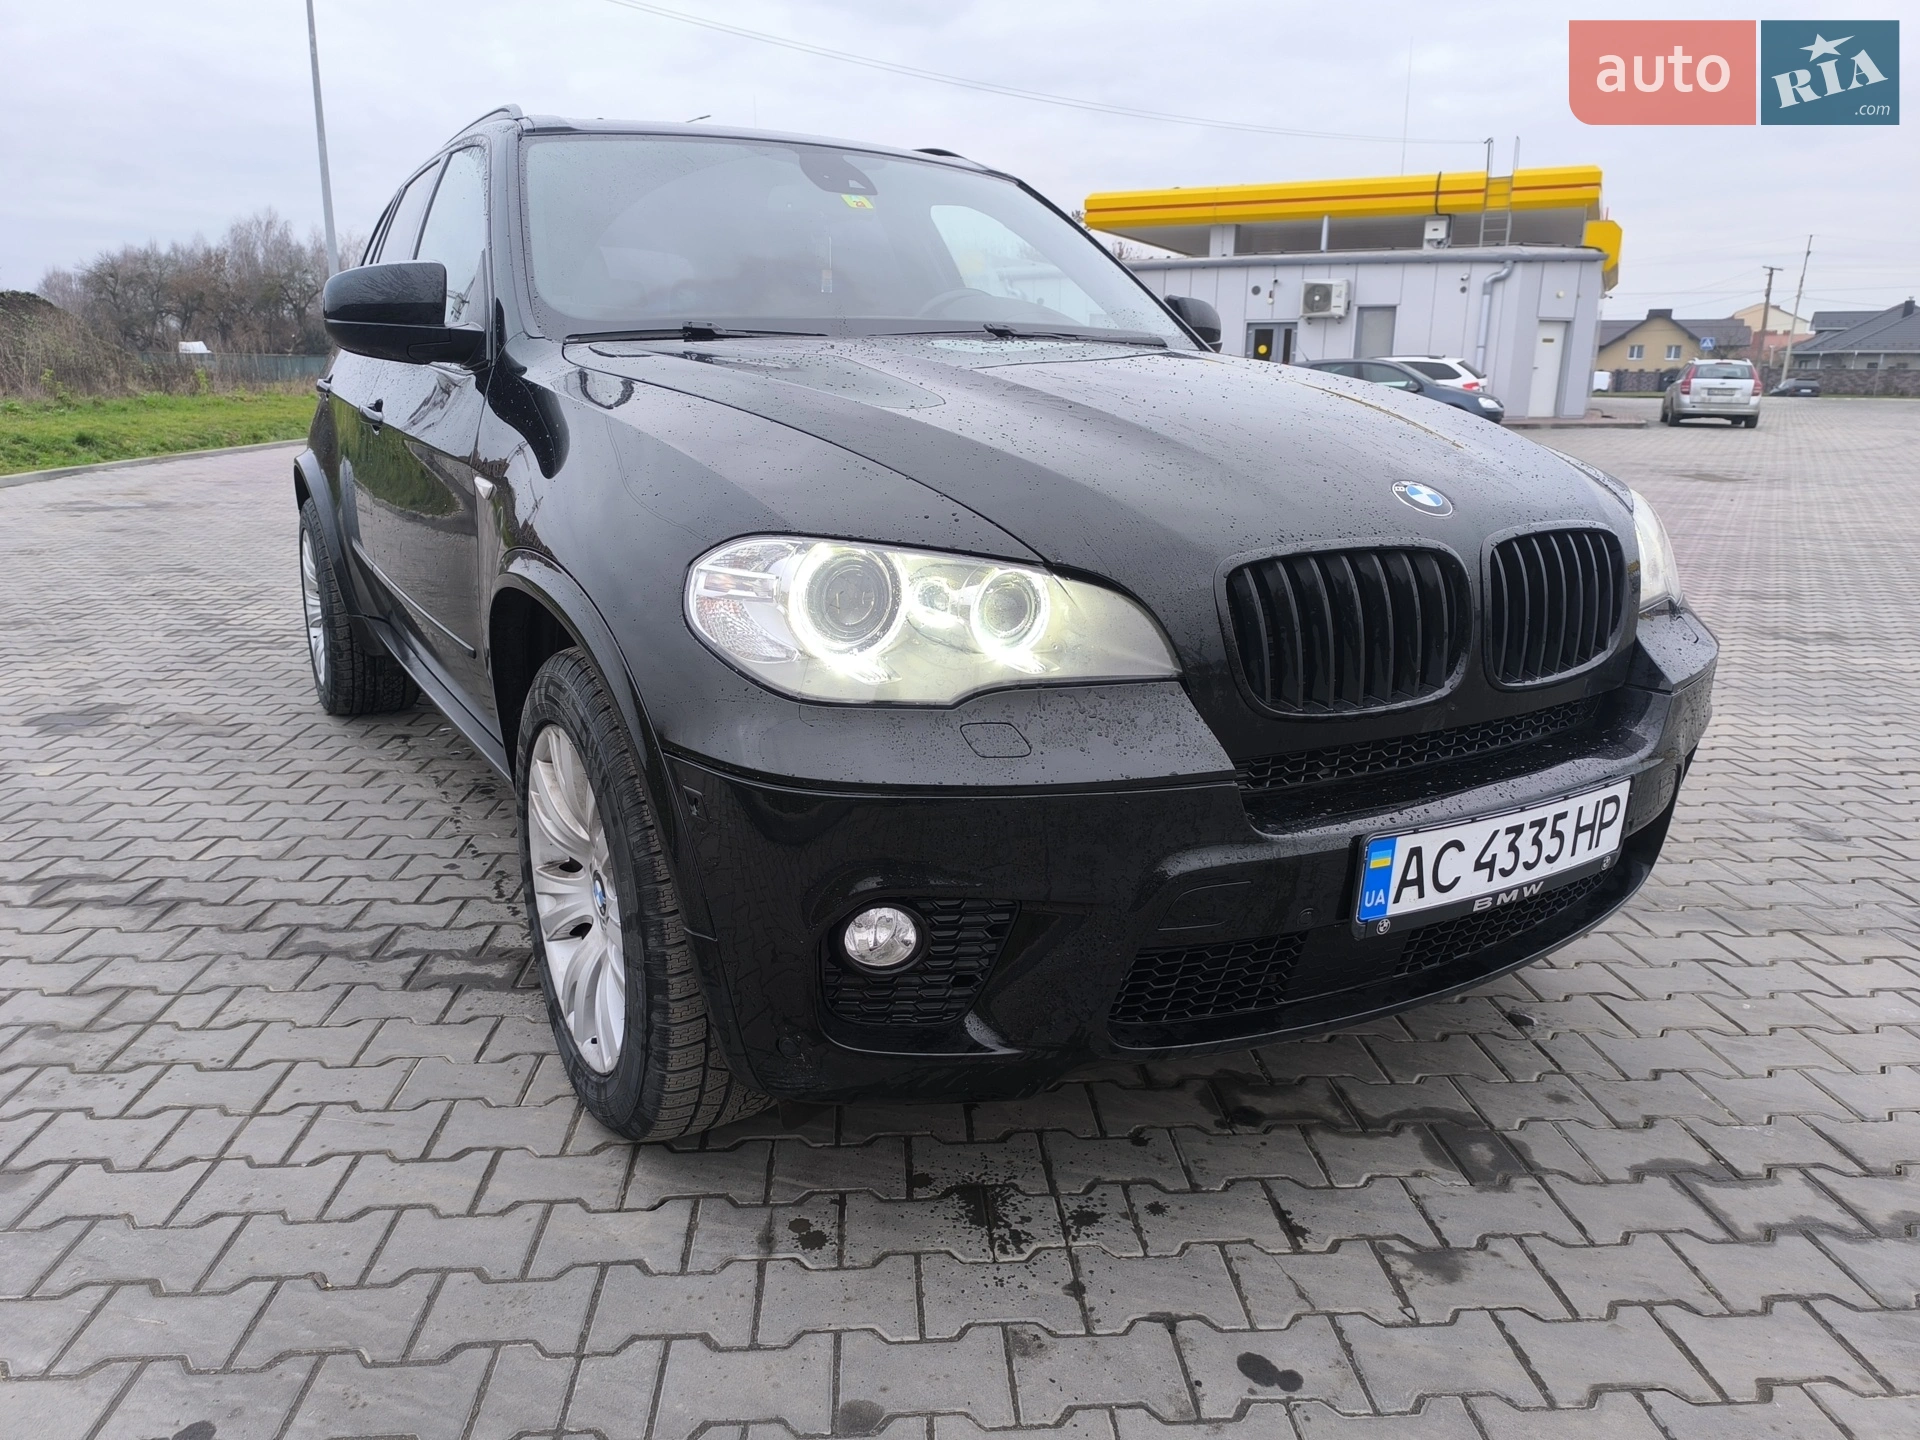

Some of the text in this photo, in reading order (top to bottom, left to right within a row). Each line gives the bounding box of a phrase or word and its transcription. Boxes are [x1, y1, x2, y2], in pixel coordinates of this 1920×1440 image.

[1392, 794, 1621, 905] AC 4335 HP
[1364, 890, 1386, 908] UA
[1472, 881, 1545, 912] BMW
